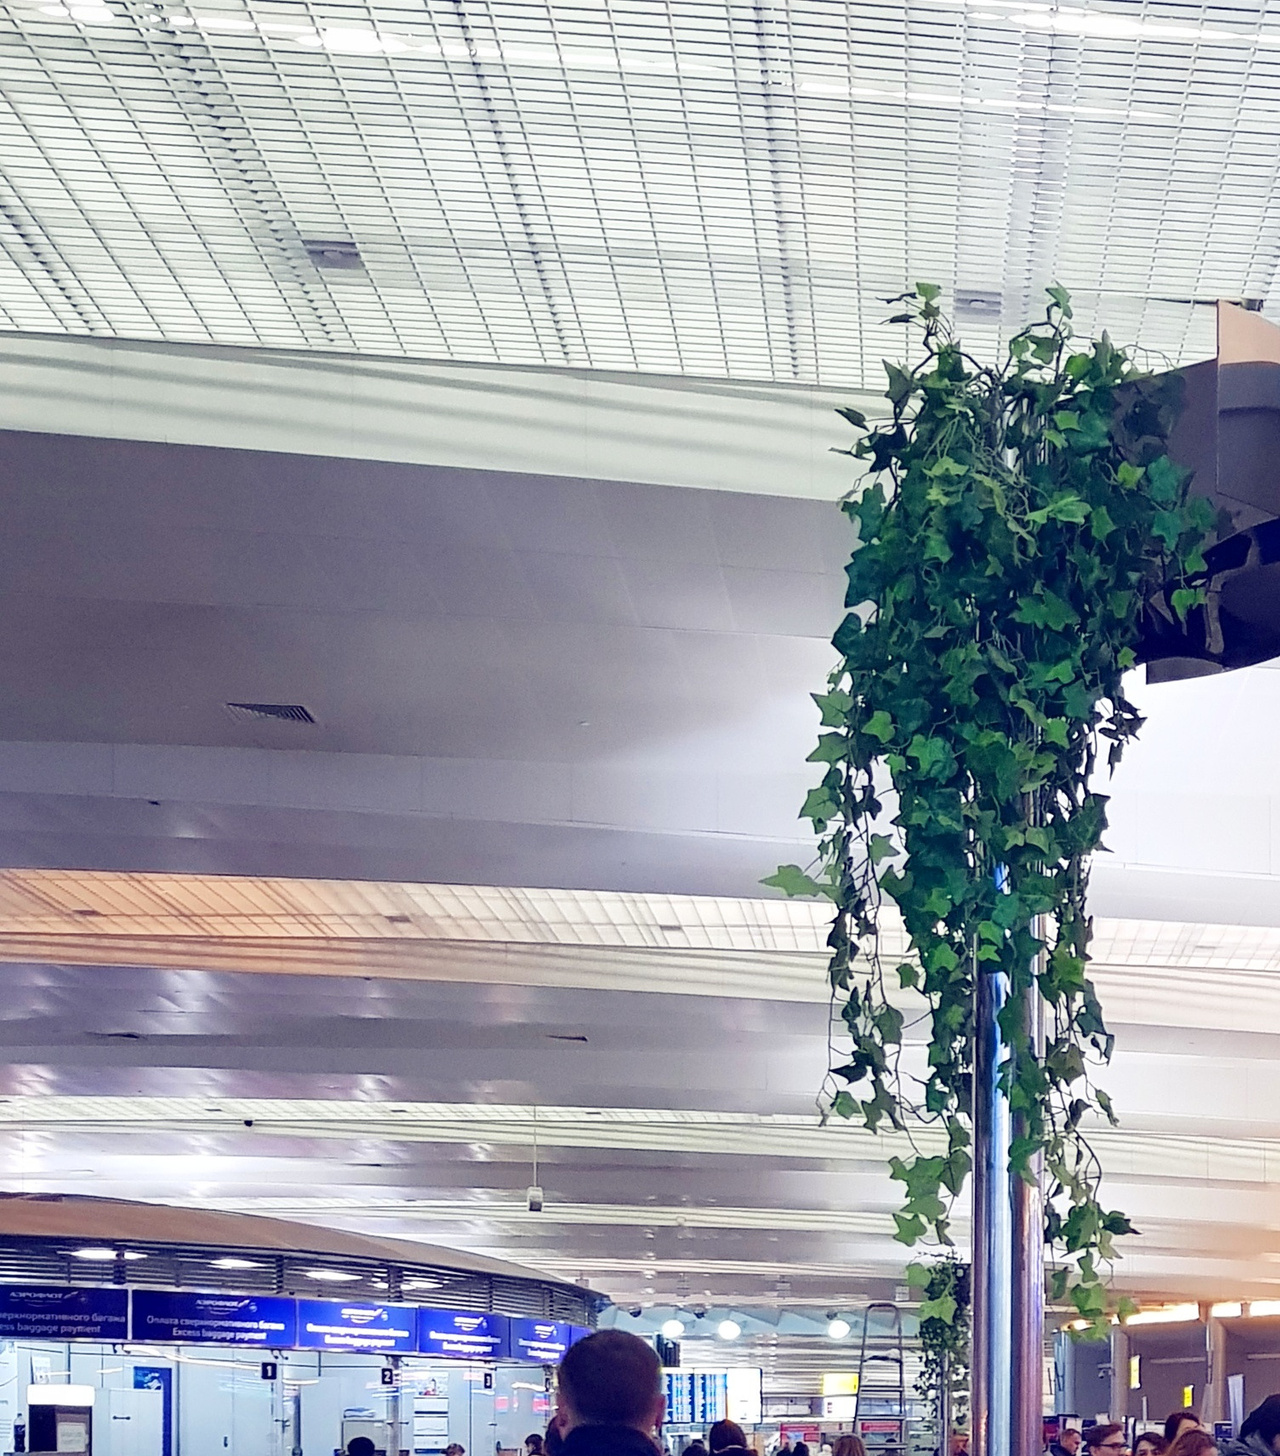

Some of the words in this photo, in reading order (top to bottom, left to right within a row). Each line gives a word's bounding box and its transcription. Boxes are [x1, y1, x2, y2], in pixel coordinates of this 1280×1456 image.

[9, 1291, 63, 1299] АЭРОФЛОТ
[146, 1315, 179, 1325] Оплата
[17, 1322, 58, 1334] baggage
[60, 1324, 101, 1335] payment
[172, 1327, 200, 1337] Excess
[265, 1365, 273, 1378] 1
[383, 1371, 392, 1382] 2
